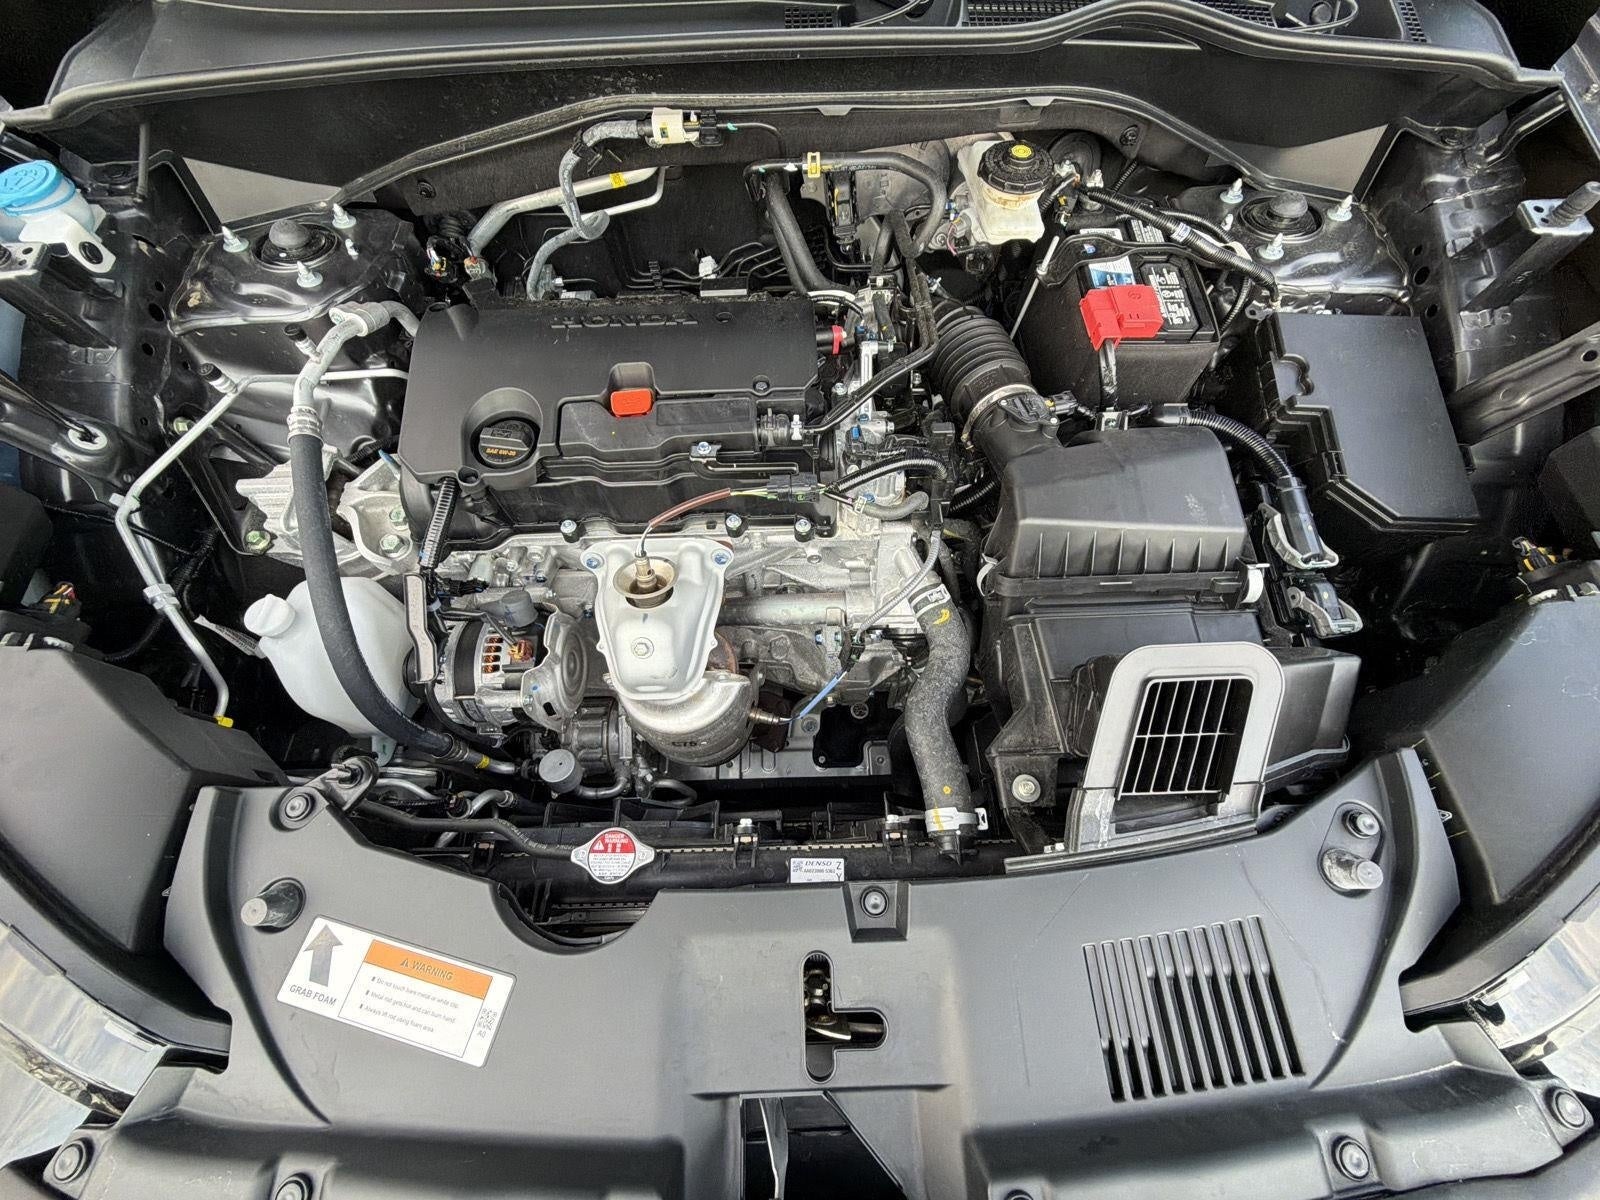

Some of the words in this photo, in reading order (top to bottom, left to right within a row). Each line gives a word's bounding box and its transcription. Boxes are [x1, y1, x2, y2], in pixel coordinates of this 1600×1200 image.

[551, 312, 698, 328] HONDA
[412, 961, 453, 980] WARNING
[289, 984, 313, 998] GRAB
[312, 992, 337, 1006] FOAM
[370, 990, 384, 1000] Metal
[411, 1005, 422, 1013] and
[364, 1004, 381, 1016] Always
